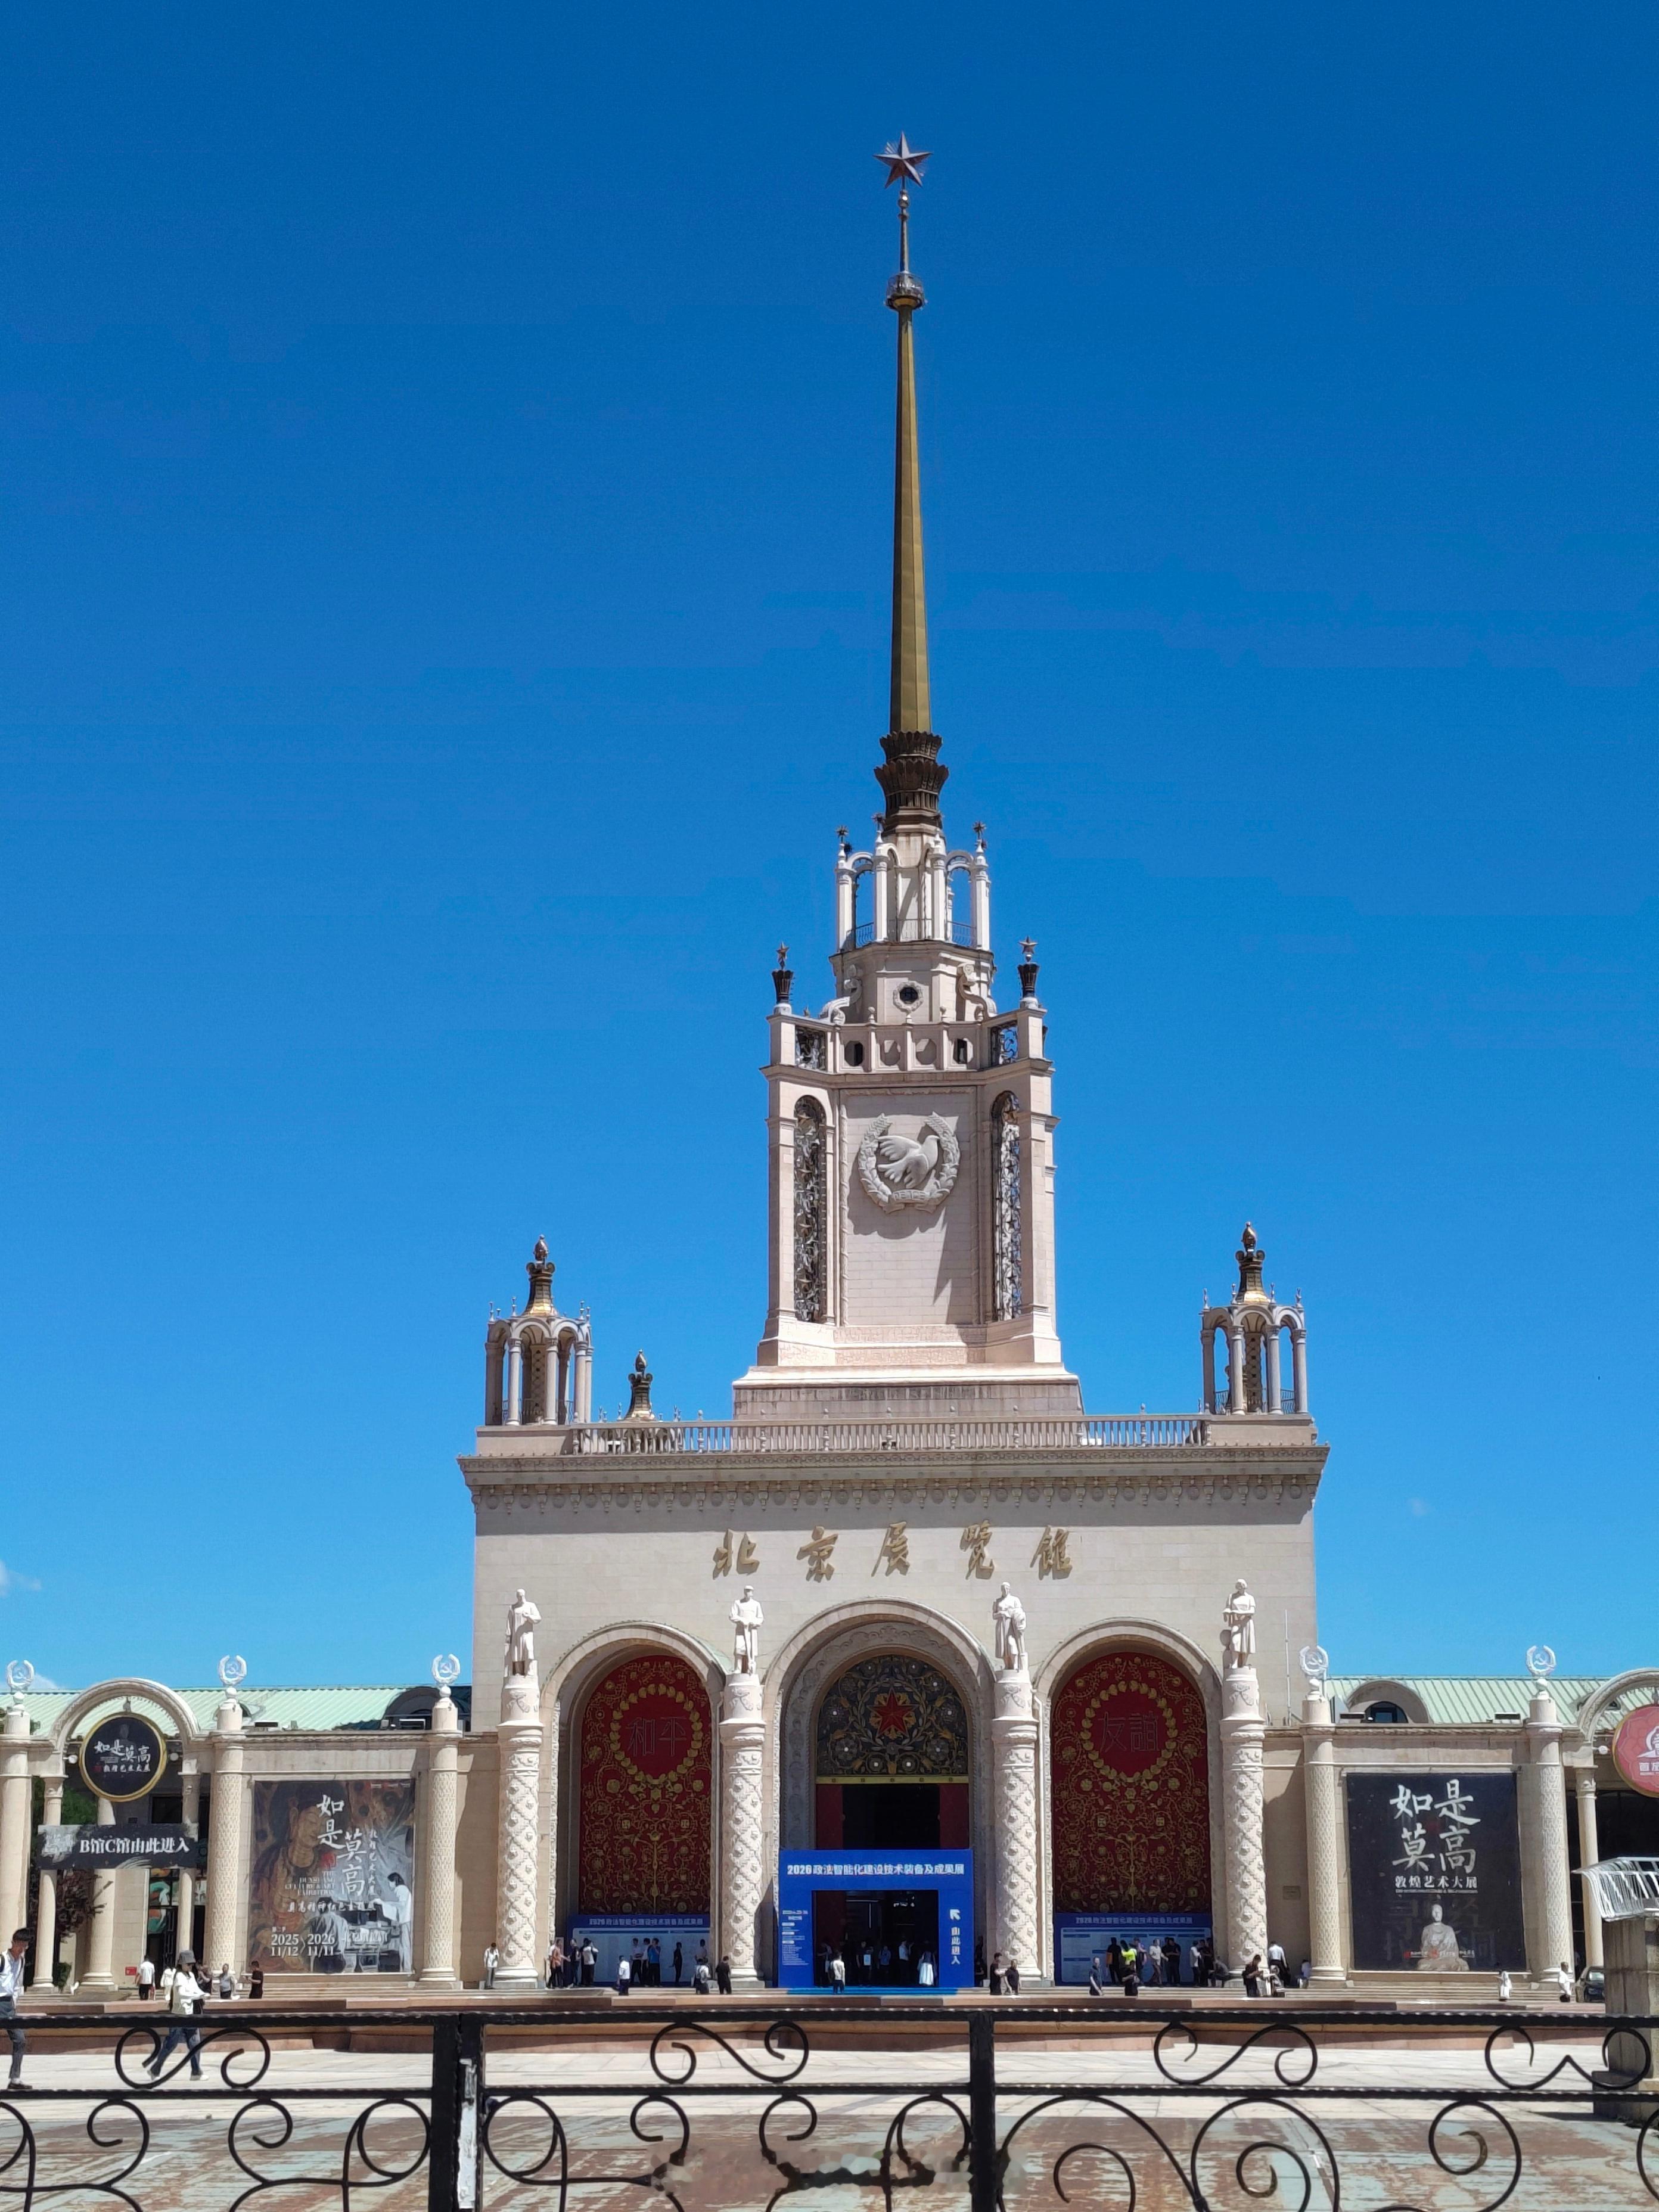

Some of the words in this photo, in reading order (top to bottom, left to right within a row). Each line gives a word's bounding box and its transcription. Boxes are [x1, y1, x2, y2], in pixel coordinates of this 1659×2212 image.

[624, 1716, 687, 1757] 和平
[1390, 1779, 1481, 1825] 如是
[1392, 1822, 1477, 1874] 莫高
[1395, 1875, 1478, 1888] 敦煌艺术大展
[271, 1934, 299, 1945] 2025
[307, 1933, 335, 1944] 2026
[271, 1946, 299, 1958] 11/12
[307, 1946, 334, 1958] 11/11
